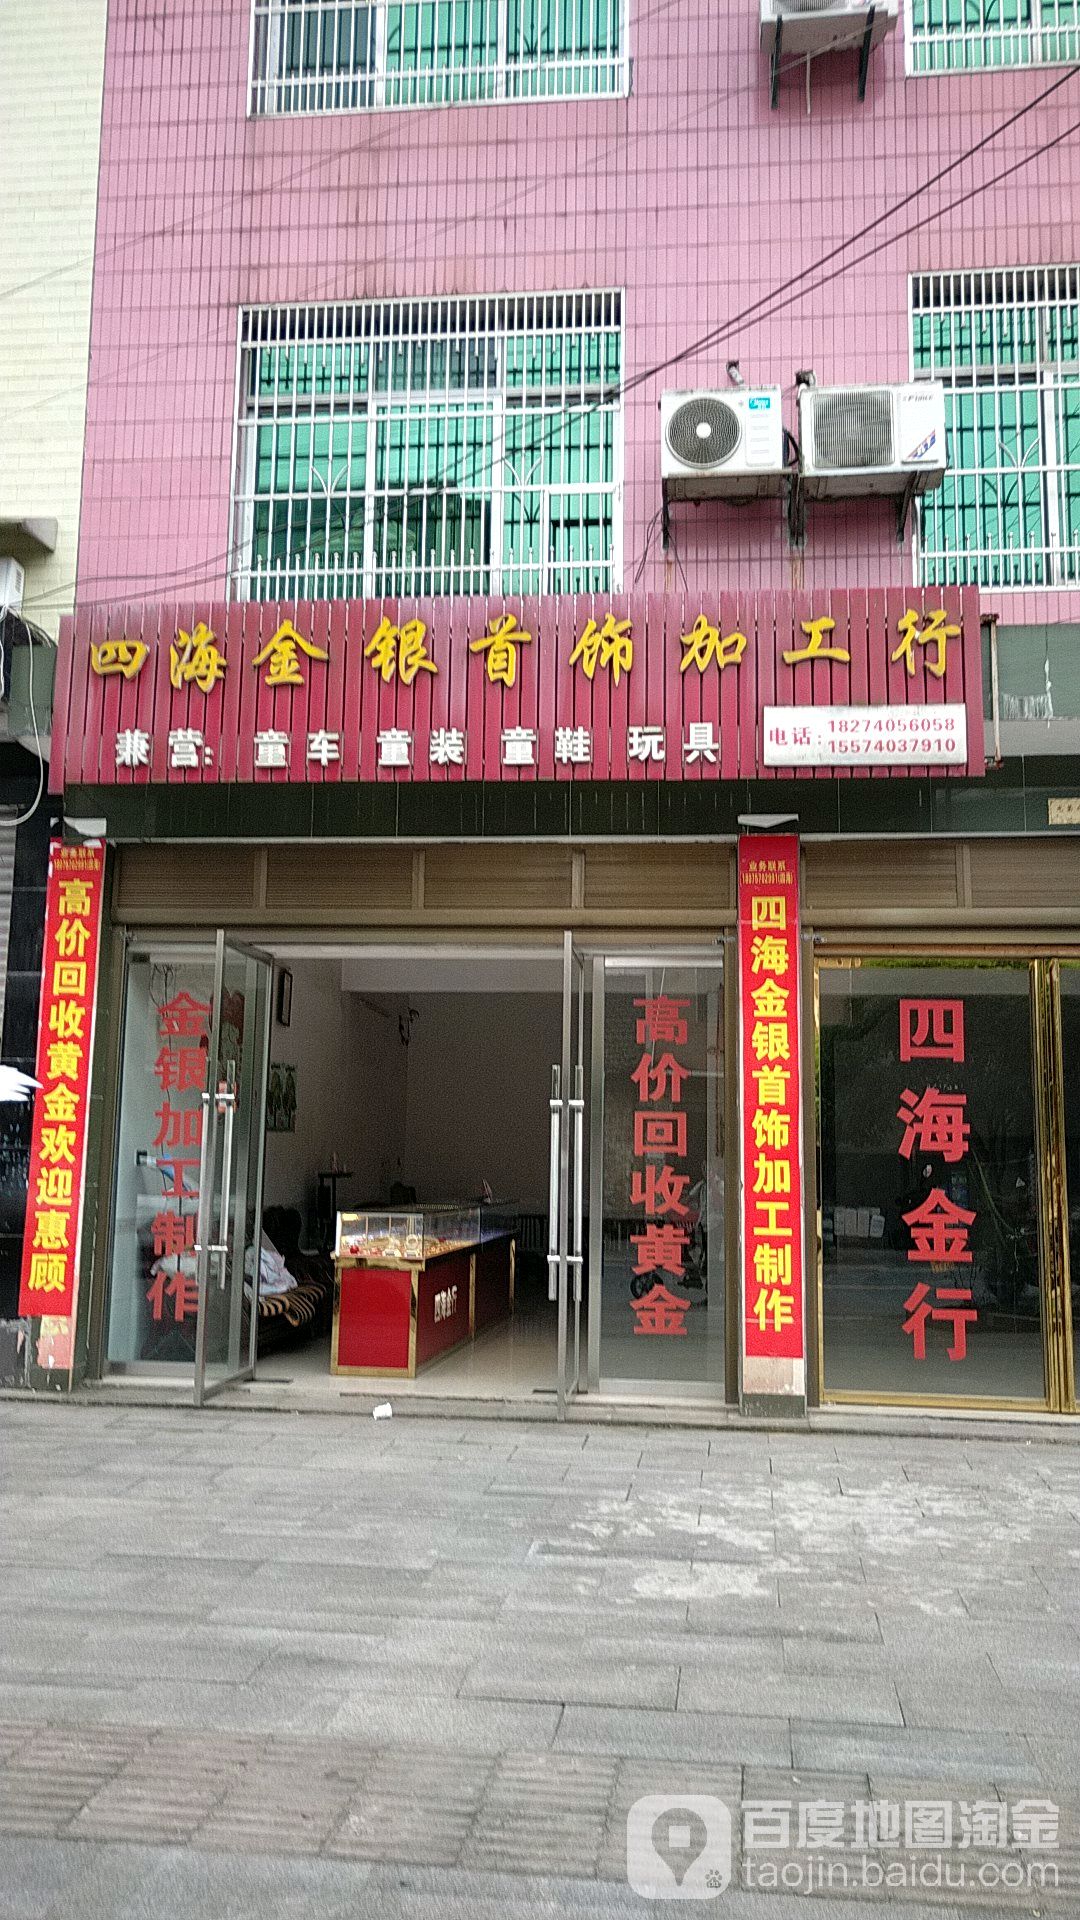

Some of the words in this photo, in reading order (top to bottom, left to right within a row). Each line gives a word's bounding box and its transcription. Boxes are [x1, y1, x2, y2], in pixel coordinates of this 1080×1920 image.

[91, 608, 961, 695] 四海金银首饰加工行
[254, 728, 343, 769] 童车
[376, 727, 466, 767] 童装
[501, 726, 592, 765] 童鞋
[627, 721, 721, 764] 玩具
[828, 718, 955, 733] 18274056058
[828, 738, 956, 754] 15574037910
[27, 878, 94, 1293] 高价回收黄金欢迎惠顾
[146, 991, 211, 1322] 金银加工制作
[629, 994, 692, 1335] 高价回收黄金
[751, 895, 795, 1332] 四海金银首饰加工制作
[896, 999, 977, 1361] 四海金行
